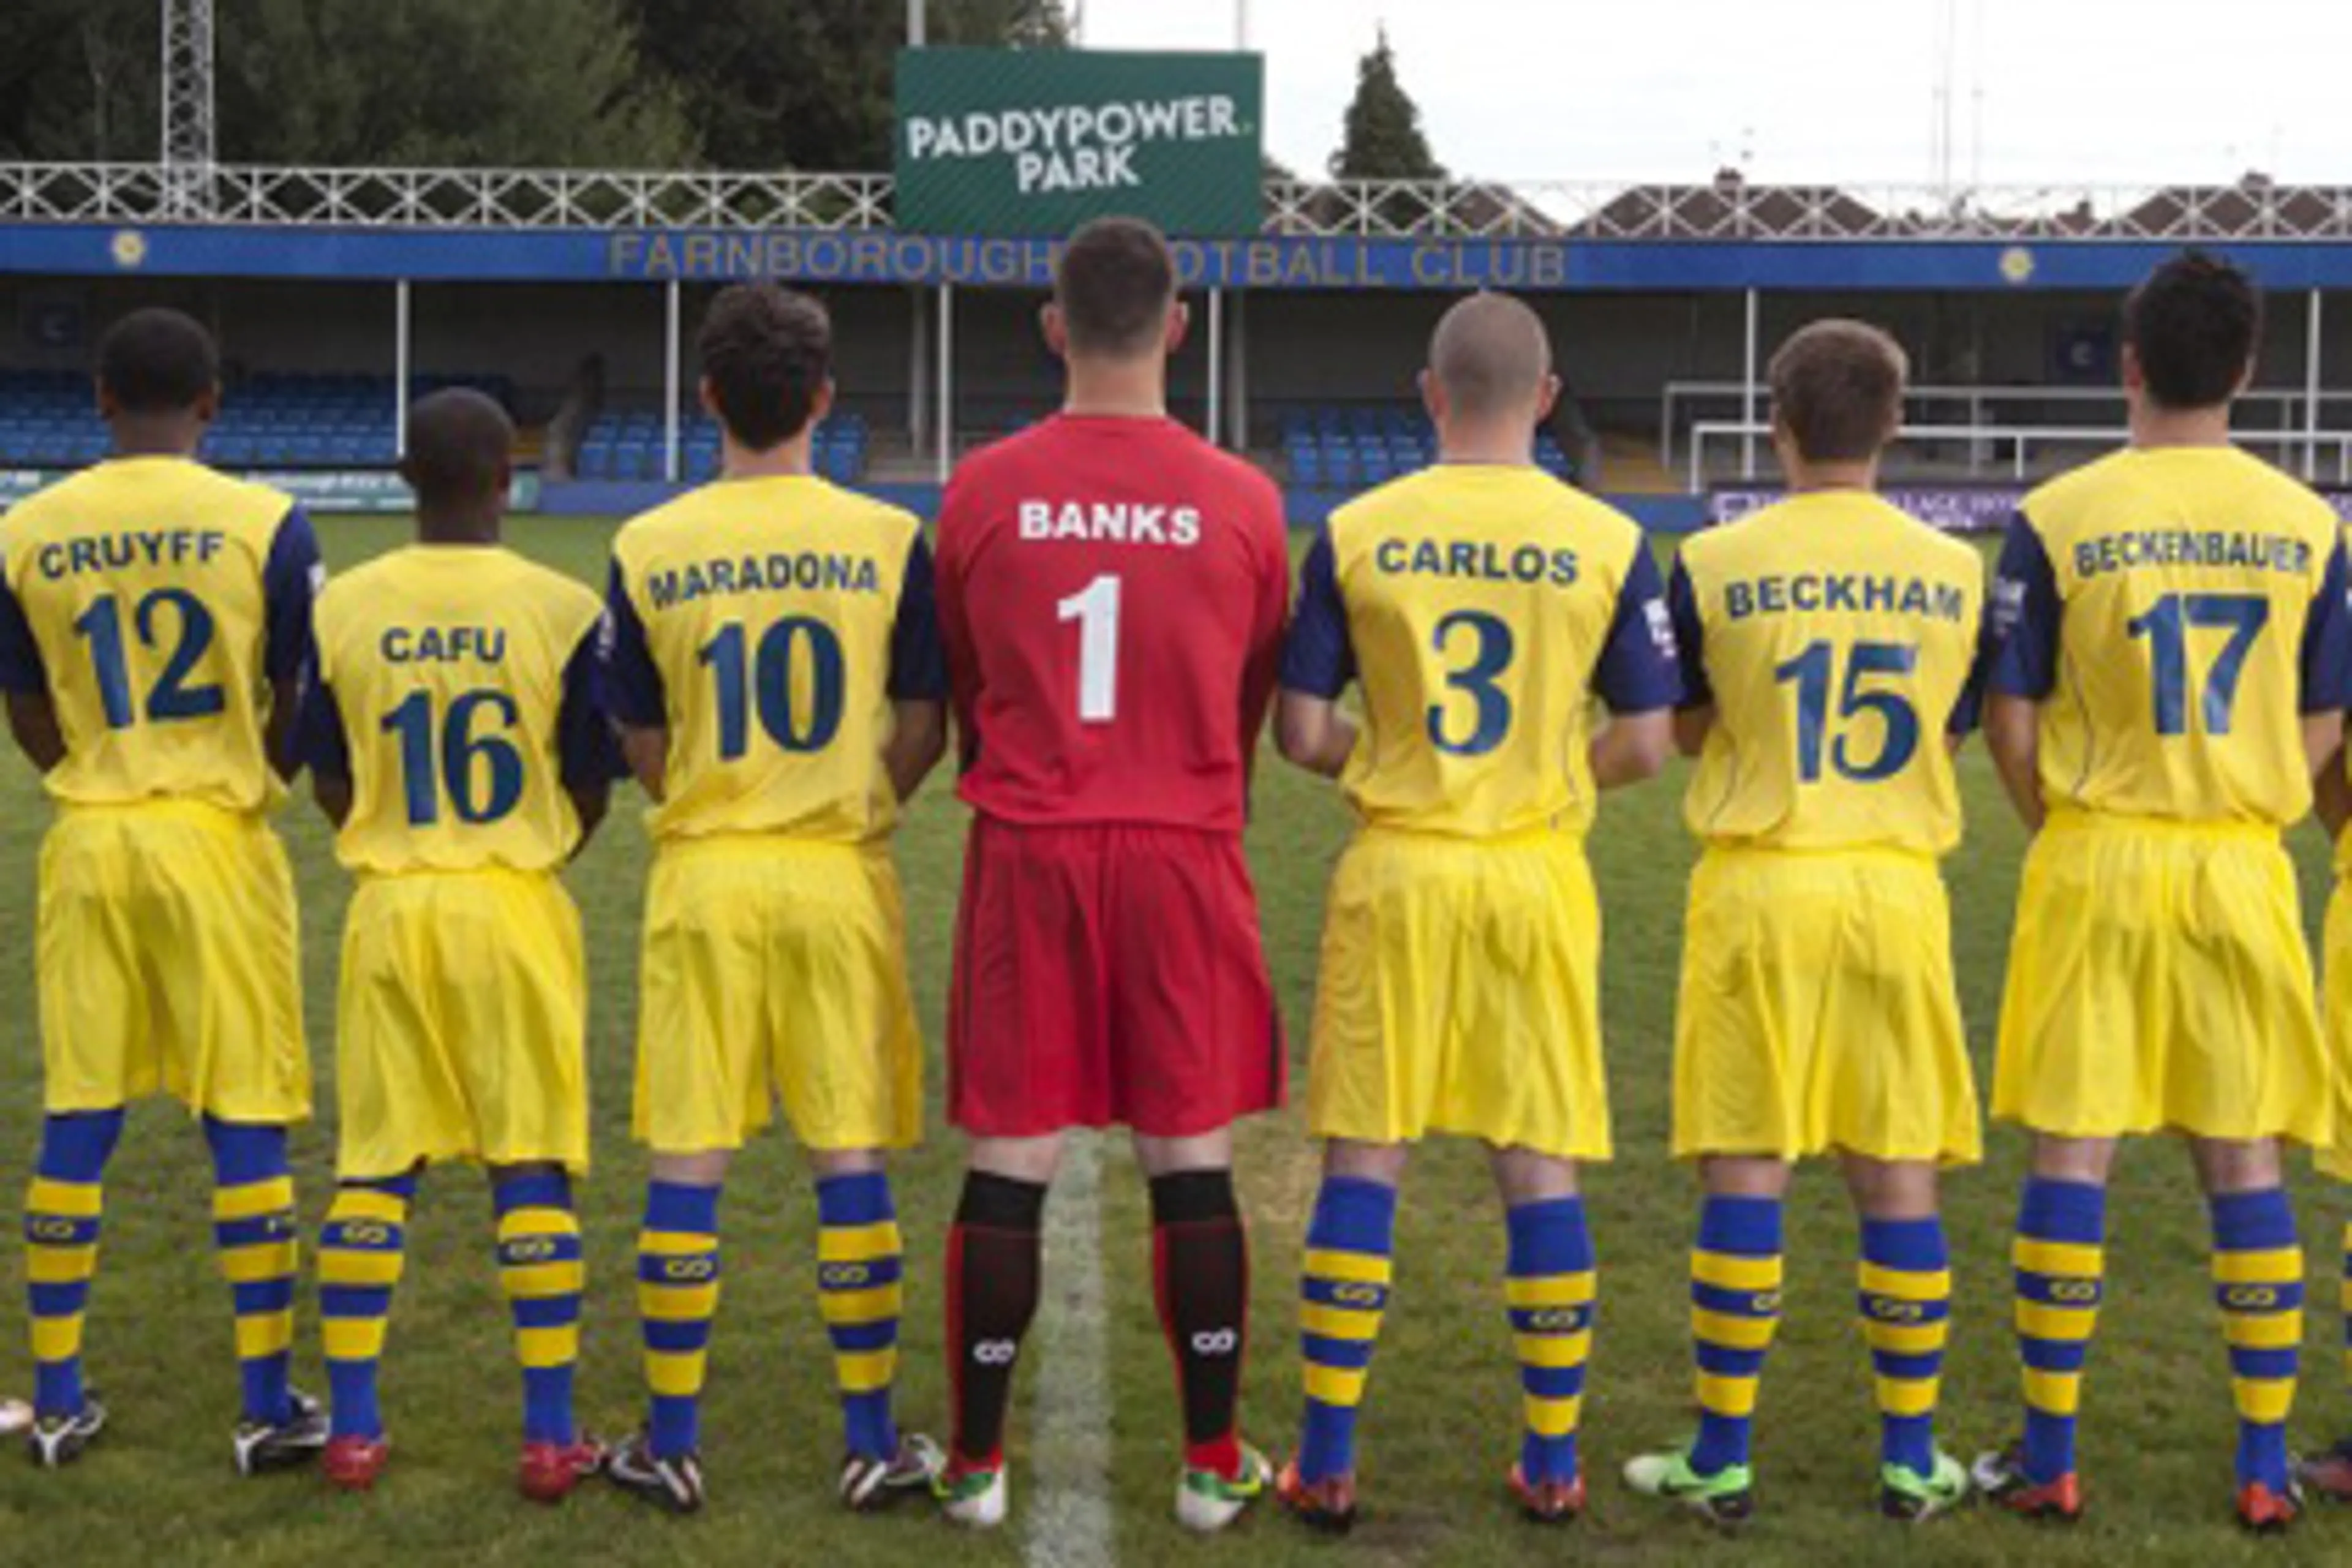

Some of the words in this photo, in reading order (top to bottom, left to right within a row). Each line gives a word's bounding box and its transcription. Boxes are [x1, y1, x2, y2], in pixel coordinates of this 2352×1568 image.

[1016, 144, 1142, 193] PARK
[612, 235, 1062, 283] FARNBOROUGH
[1165, 239, 1384, 287] OTBALL
[1411, 243, 1565, 288] CLUB
[1019, 502, 1202, 546] BANKS
[39, 530, 225, 579] CRUYFF
[1376, 537, 1579, 586] CARLOS
[2075, 530, 2314, 578] BECKENBAUER
[647, 553, 880, 611] MARADONA
[1724, 574, 1962, 624] BECKHAM
[72, 587, 225, 730] 12
[381, 627, 505, 664] CAFU
[1057, 574, 1120, 723] 1
[2128, 593, 2271, 736] 17
[696, 614, 846, 763] 10
[1426, 609, 1514, 757] 3
[1774, 638, 1921, 784] 15
[380, 688, 526, 827] 16
